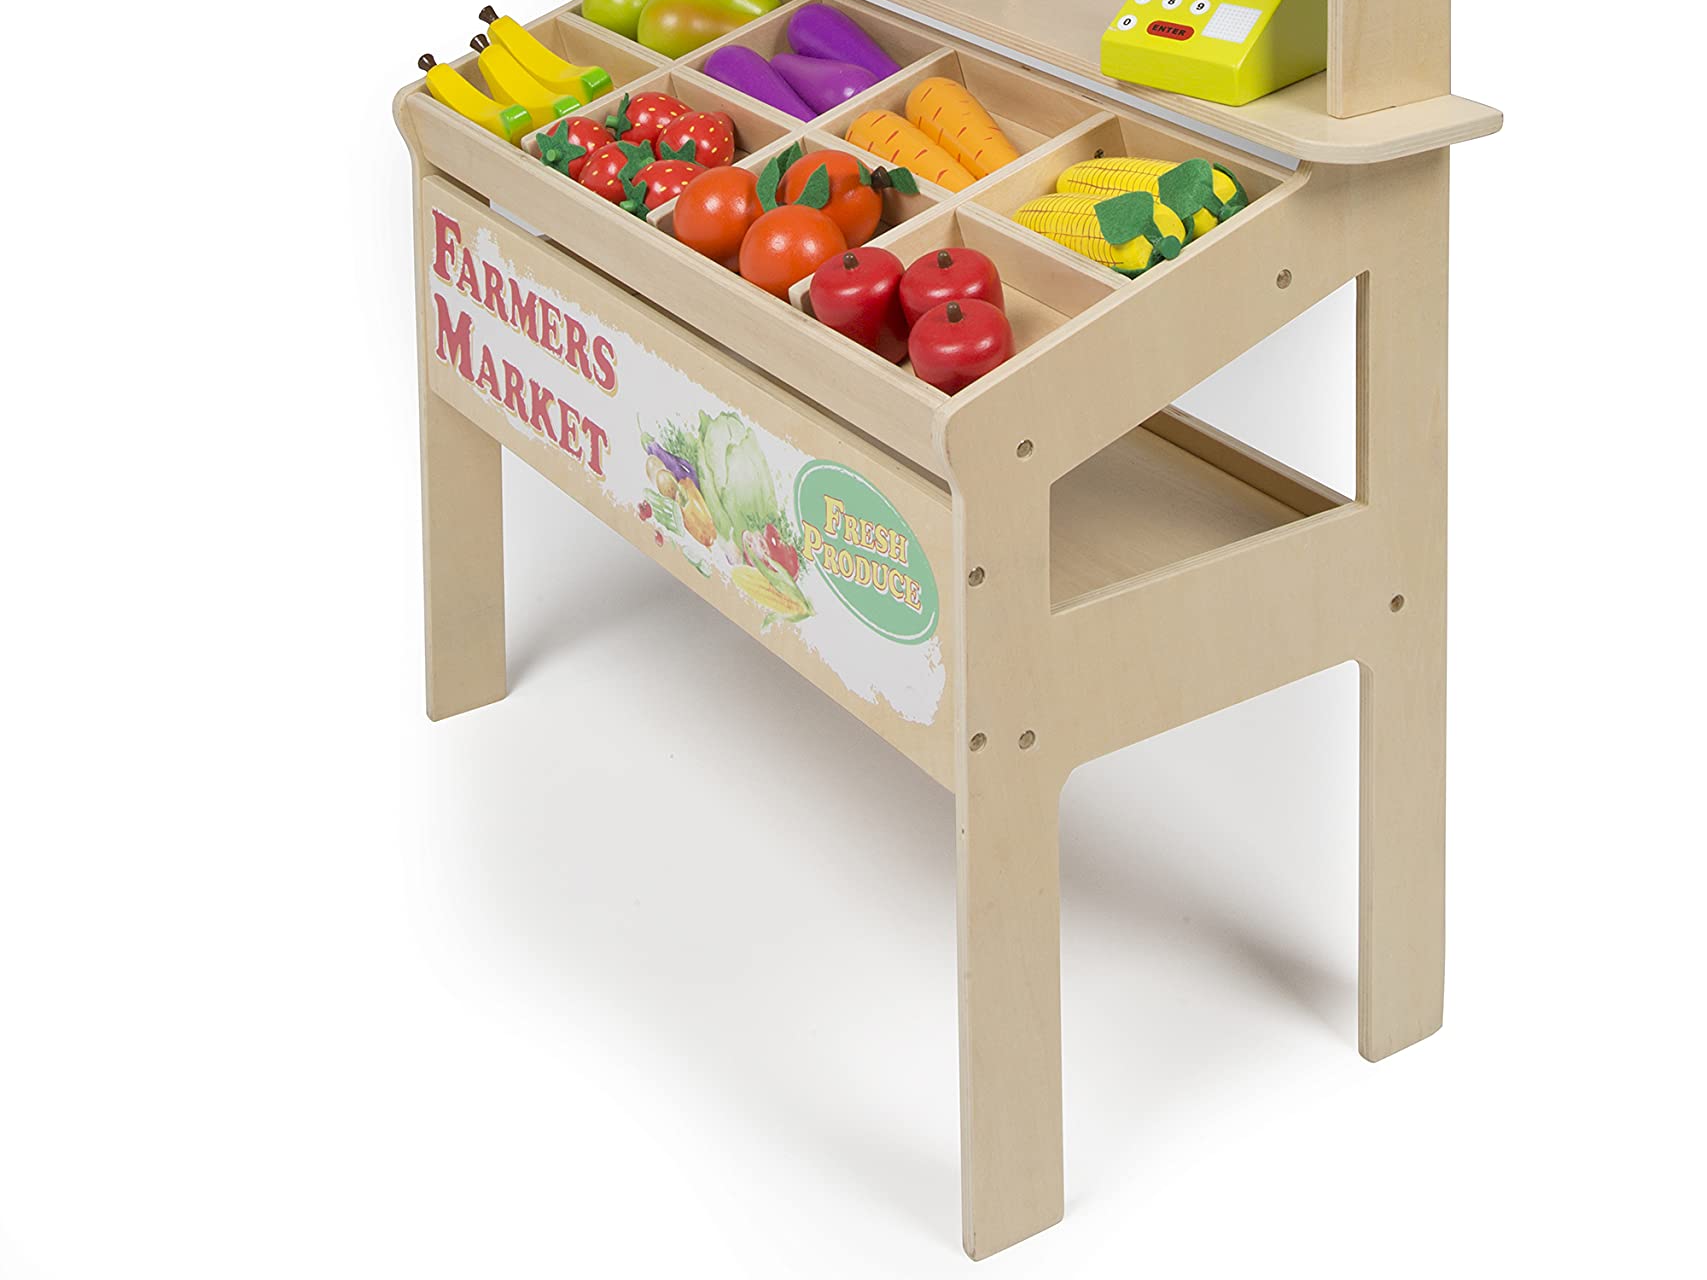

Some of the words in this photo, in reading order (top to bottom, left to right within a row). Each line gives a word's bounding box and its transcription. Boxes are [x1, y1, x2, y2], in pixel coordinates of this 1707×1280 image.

[1122, 18, 1132, 26] 0
[1151, 24, 1187, 37] ENTER
[1196, 2, 1206, 11] 9
[432, 208, 617, 395] FARMERS
[434, 292, 610, 479] MARKET
[801, 520, 922, 614] PRODUCE
[823, 494, 908, 567] FRESH
